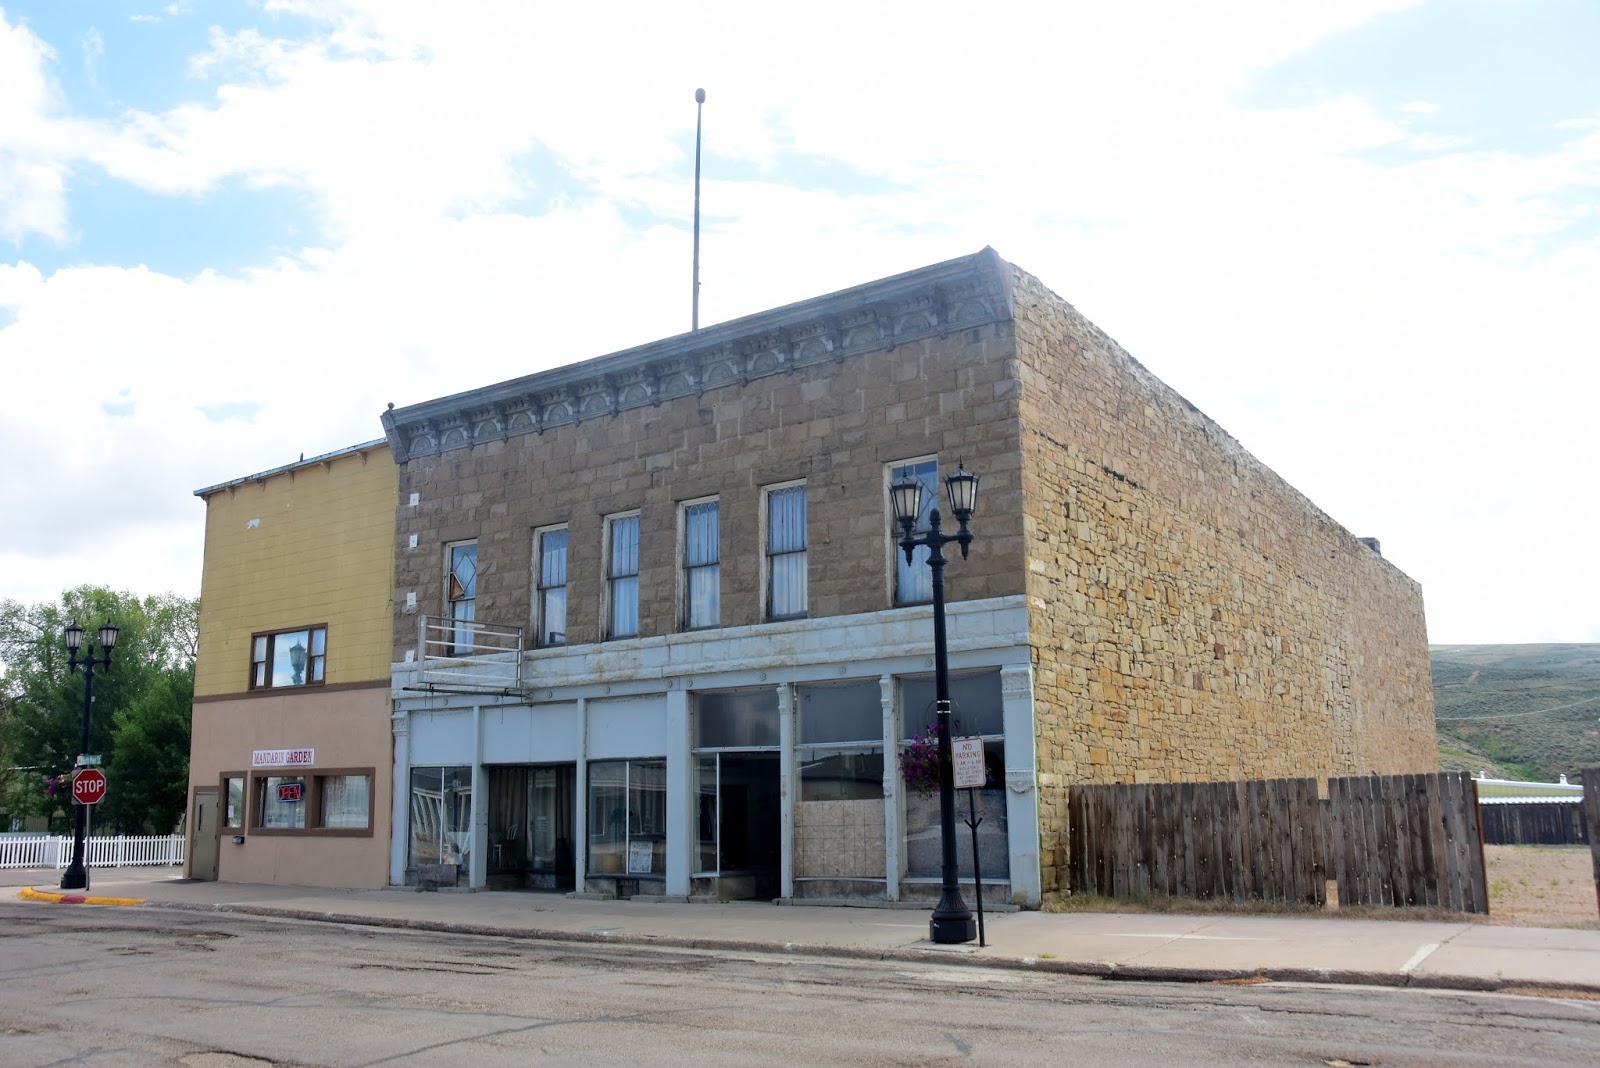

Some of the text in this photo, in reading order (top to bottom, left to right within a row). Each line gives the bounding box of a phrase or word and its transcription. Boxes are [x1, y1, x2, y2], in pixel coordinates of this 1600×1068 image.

[962, 743, 973, 751] NO
[254, 751, 312, 764] MANDARIN GARDEN
[955, 751, 981, 759] PARKING
[75, 779, 104, 793] STOP
[278, 786, 300, 800] OPEN
